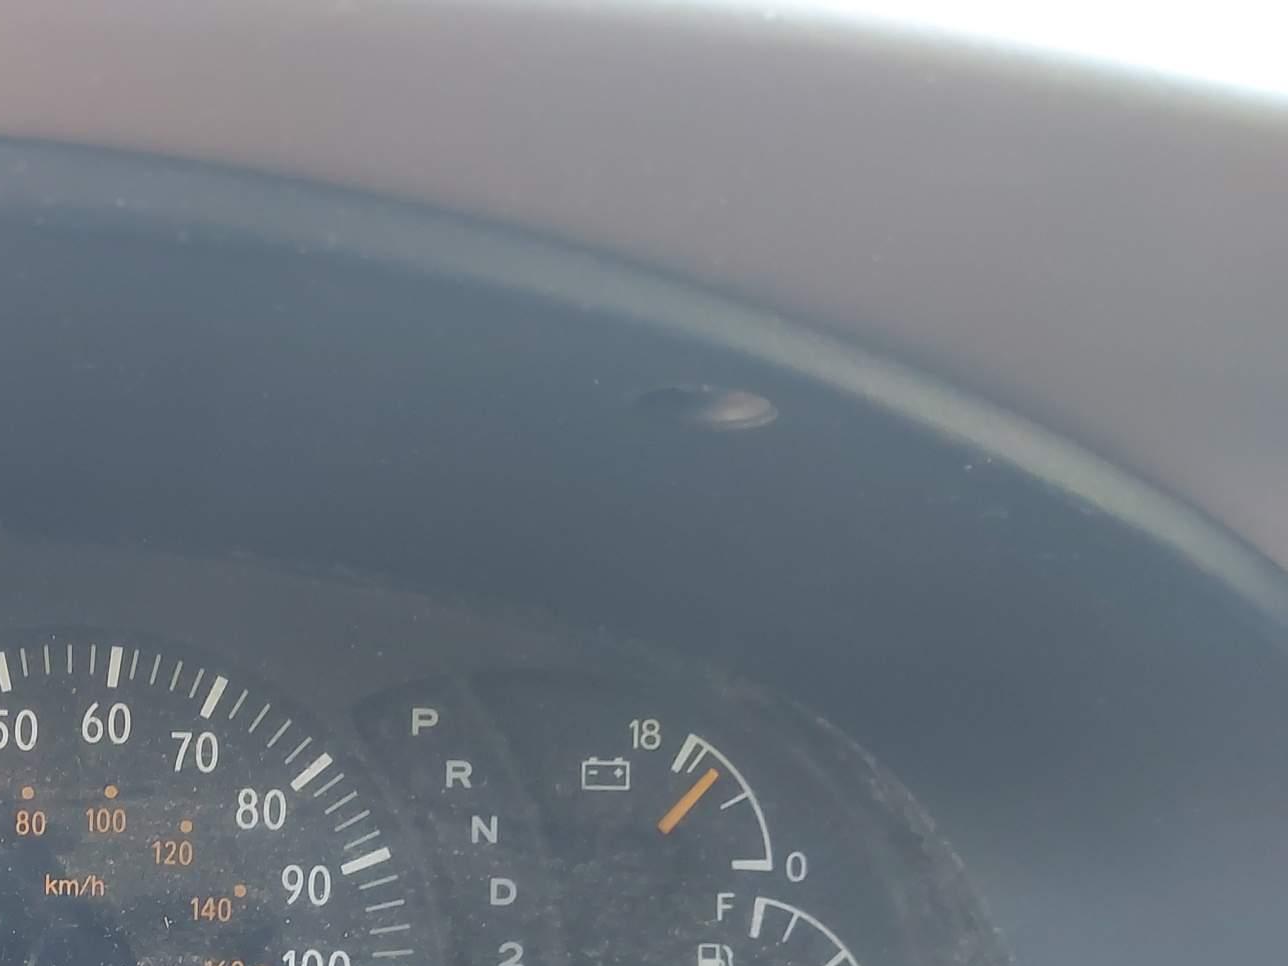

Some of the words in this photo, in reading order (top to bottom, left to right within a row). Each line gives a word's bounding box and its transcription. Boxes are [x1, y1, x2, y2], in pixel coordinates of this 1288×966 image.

[81, 703, 132, 745] 60
[412, 708, 439, 736] P
[628, 719, 661, 750] 18
[171, 731, 220, 774] 70
[446, 760, 473, 789] R
[15, 810, 47, 837] 80
[86, 808, 126, 834] 100
[235, 788, 287, 831] 80
[471, 816, 498, 844] N
[152, 840, 193, 866] 120
[786, 851, 808, 882] 0
[44, 874, 105, 898] km/h
[281, 864, 332, 907] 90
[490, 878, 517, 906] D
[190, 897, 231, 923] 140
[716, 893, 736, 922] F
